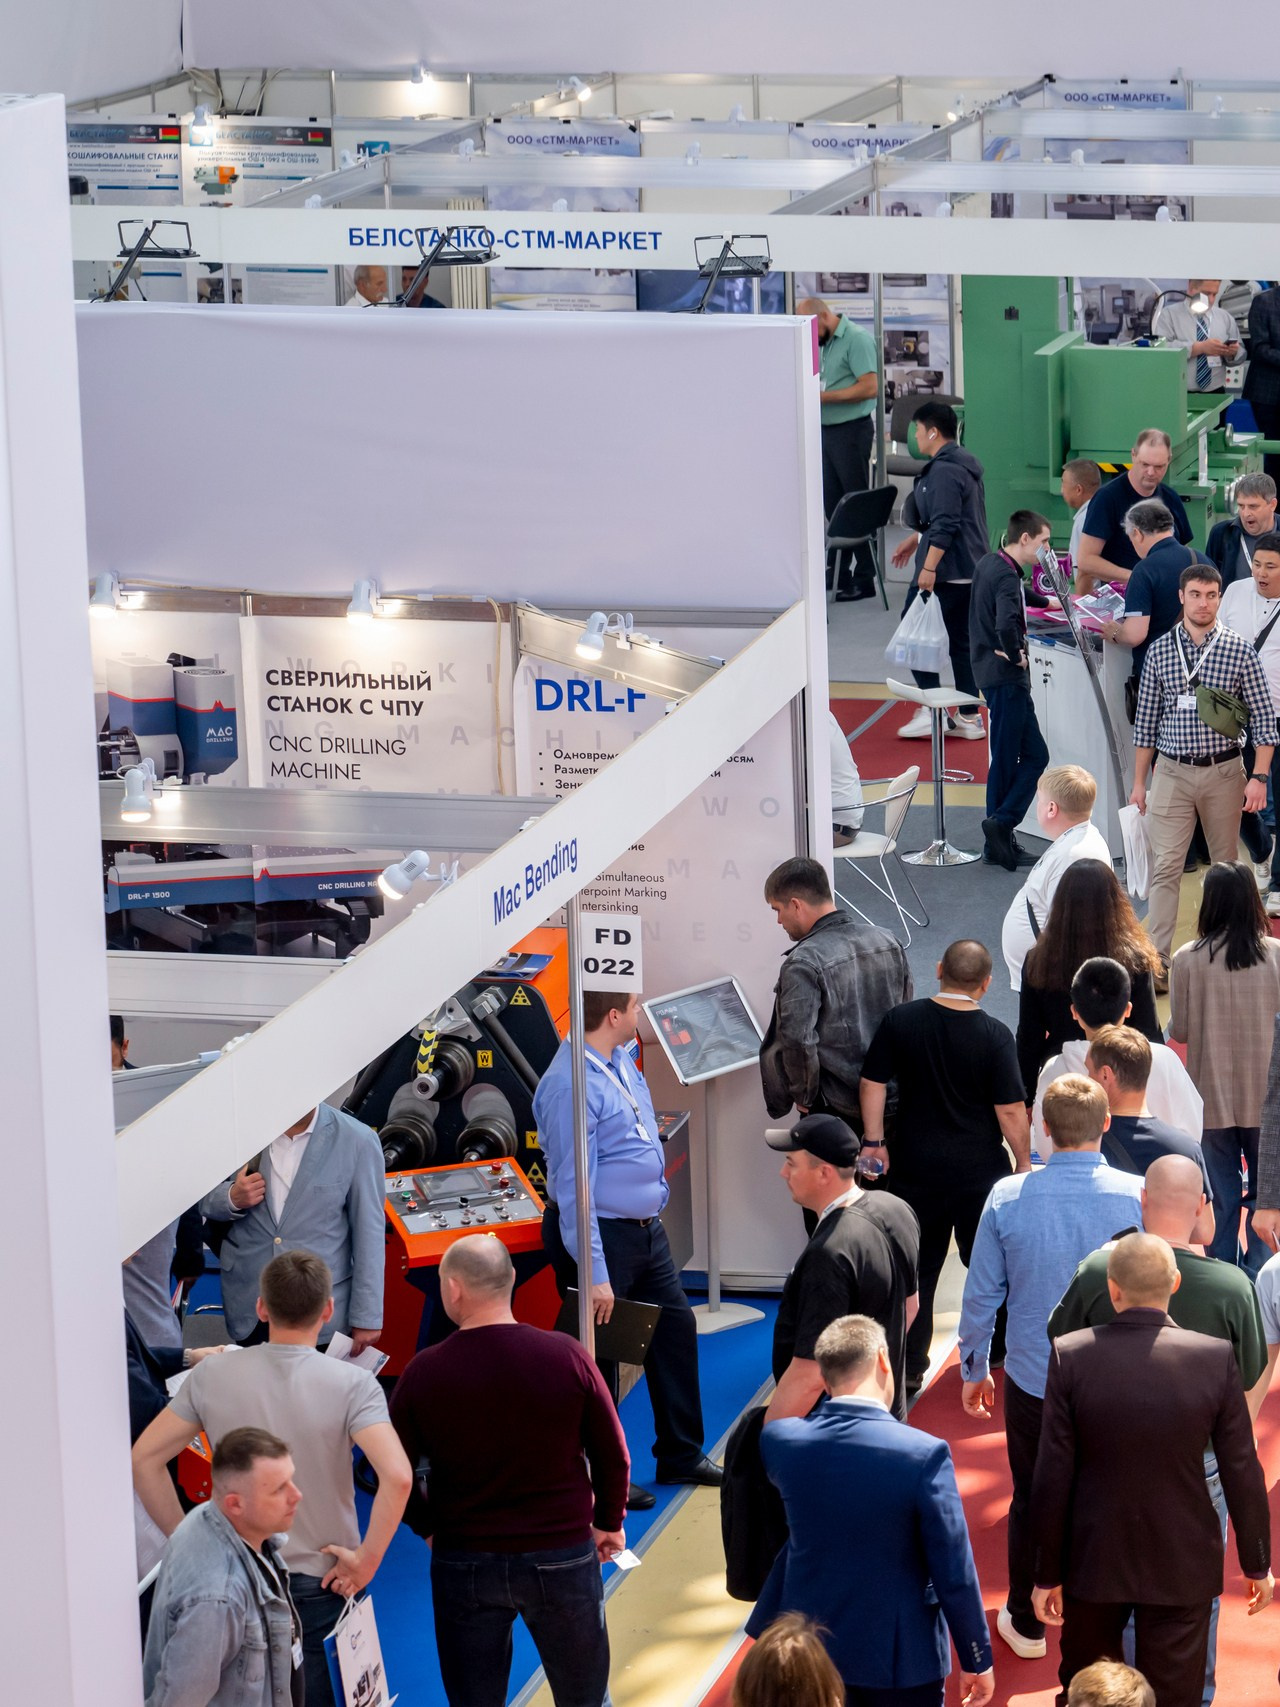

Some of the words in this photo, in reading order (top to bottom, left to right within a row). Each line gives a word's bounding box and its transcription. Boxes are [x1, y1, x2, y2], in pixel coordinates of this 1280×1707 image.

[1064, 92, 1089, 102] ООО
[1091, 93, 1171, 102] «СТМ-МАРКЕТ»
[507, 135, 533, 145] ООО
[536, 135, 620, 146] «СТМ-МАРКЕТ»
[812, 138, 838, 148] ООО
[349, 227, 662, 251] БЕЛСТАНКО-СТМ-МАРКЕТ
[265, 669, 432, 691] СВЕРЛИЛЬНЫЙ
[267, 695, 353, 715] СТАНОК
[359, 698, 374, 715] С
[381, 699, 424, 716] ЧПУ
[269, 735, 312, 753] CNC
[320, 737, 407, 756] DRILLING
[270, 761, 361, 780] MACHINE
[318, 882, 334, 891] CNC
[335, 880, 366, 890] DRILLING
[493, 882, 521, 926] Mac
[524, 838, 578, 900] Bending
[152, 890, 170, 899] 1500
[624, 887, 667, 900] Marking
[595, 927, 632, 946] FD
[584, 957, 635, 976] 022
